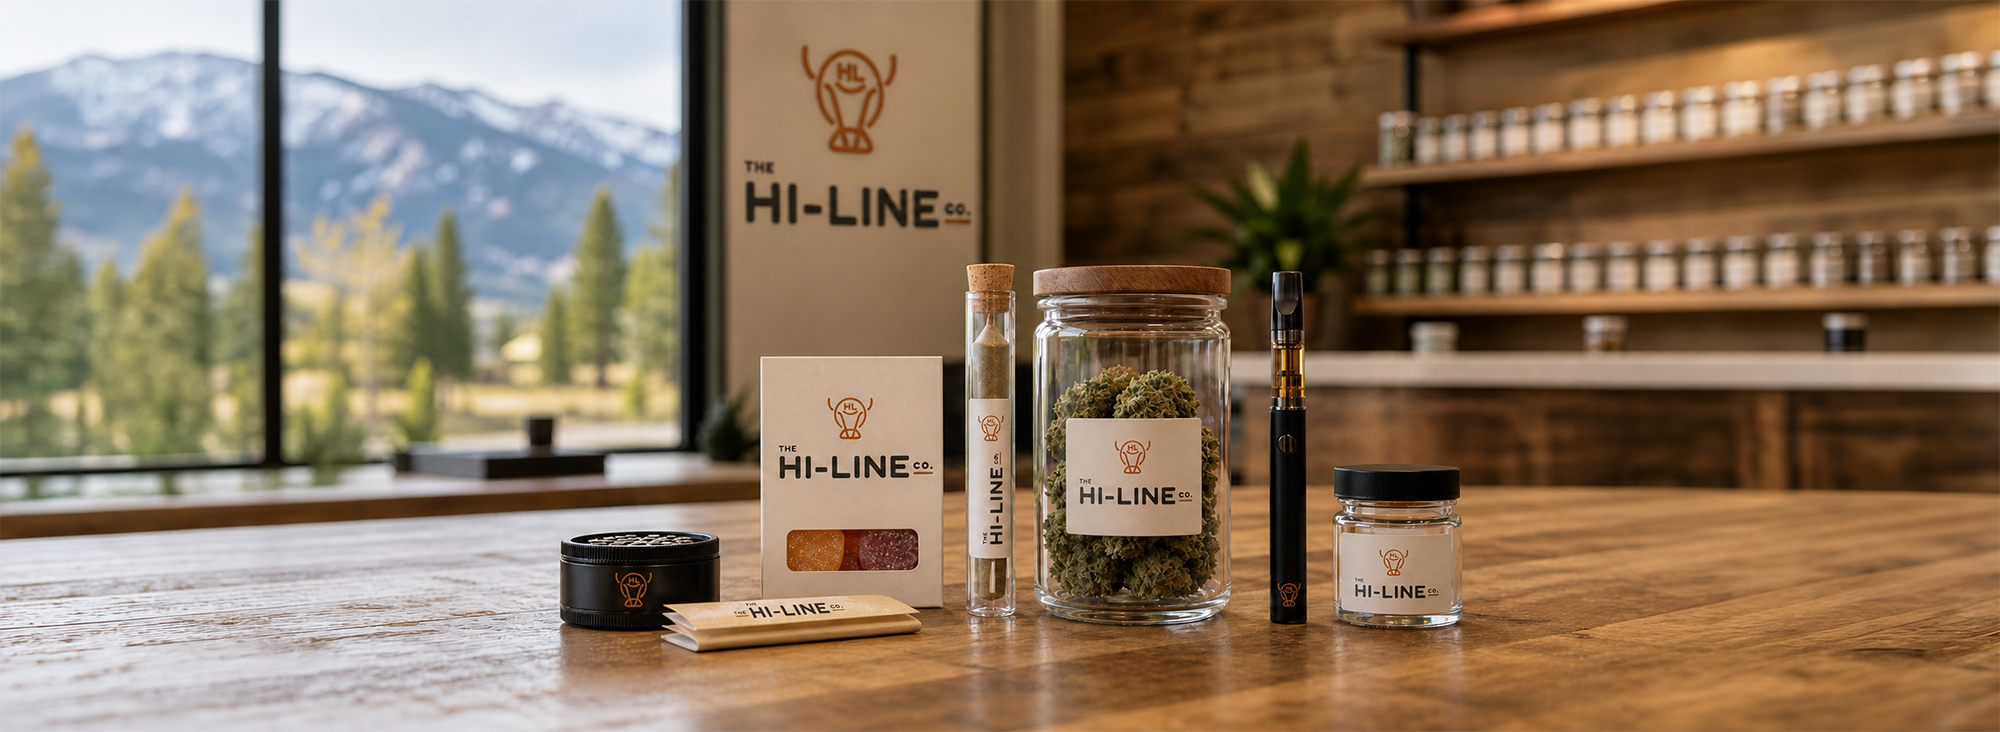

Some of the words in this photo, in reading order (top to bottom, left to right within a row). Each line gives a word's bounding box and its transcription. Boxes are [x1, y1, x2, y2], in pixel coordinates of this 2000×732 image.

[837, 63, 865, 82] HL
[744, 160, 775, 174] THE
[746, 181, 939, 228] HI-LINE
[843, 403, 858, 411] HL
[779, 455, 910, 479] HI-LINE
[1079, 486, 1176, 505] HI-LINE
[989, 467, 1003, 545] HI-LINE
[628, 576, 640, 584] HL
[1354, 584, 1426, 599] HI-LINE
[748, 602, 831, 619] HI-LINE
